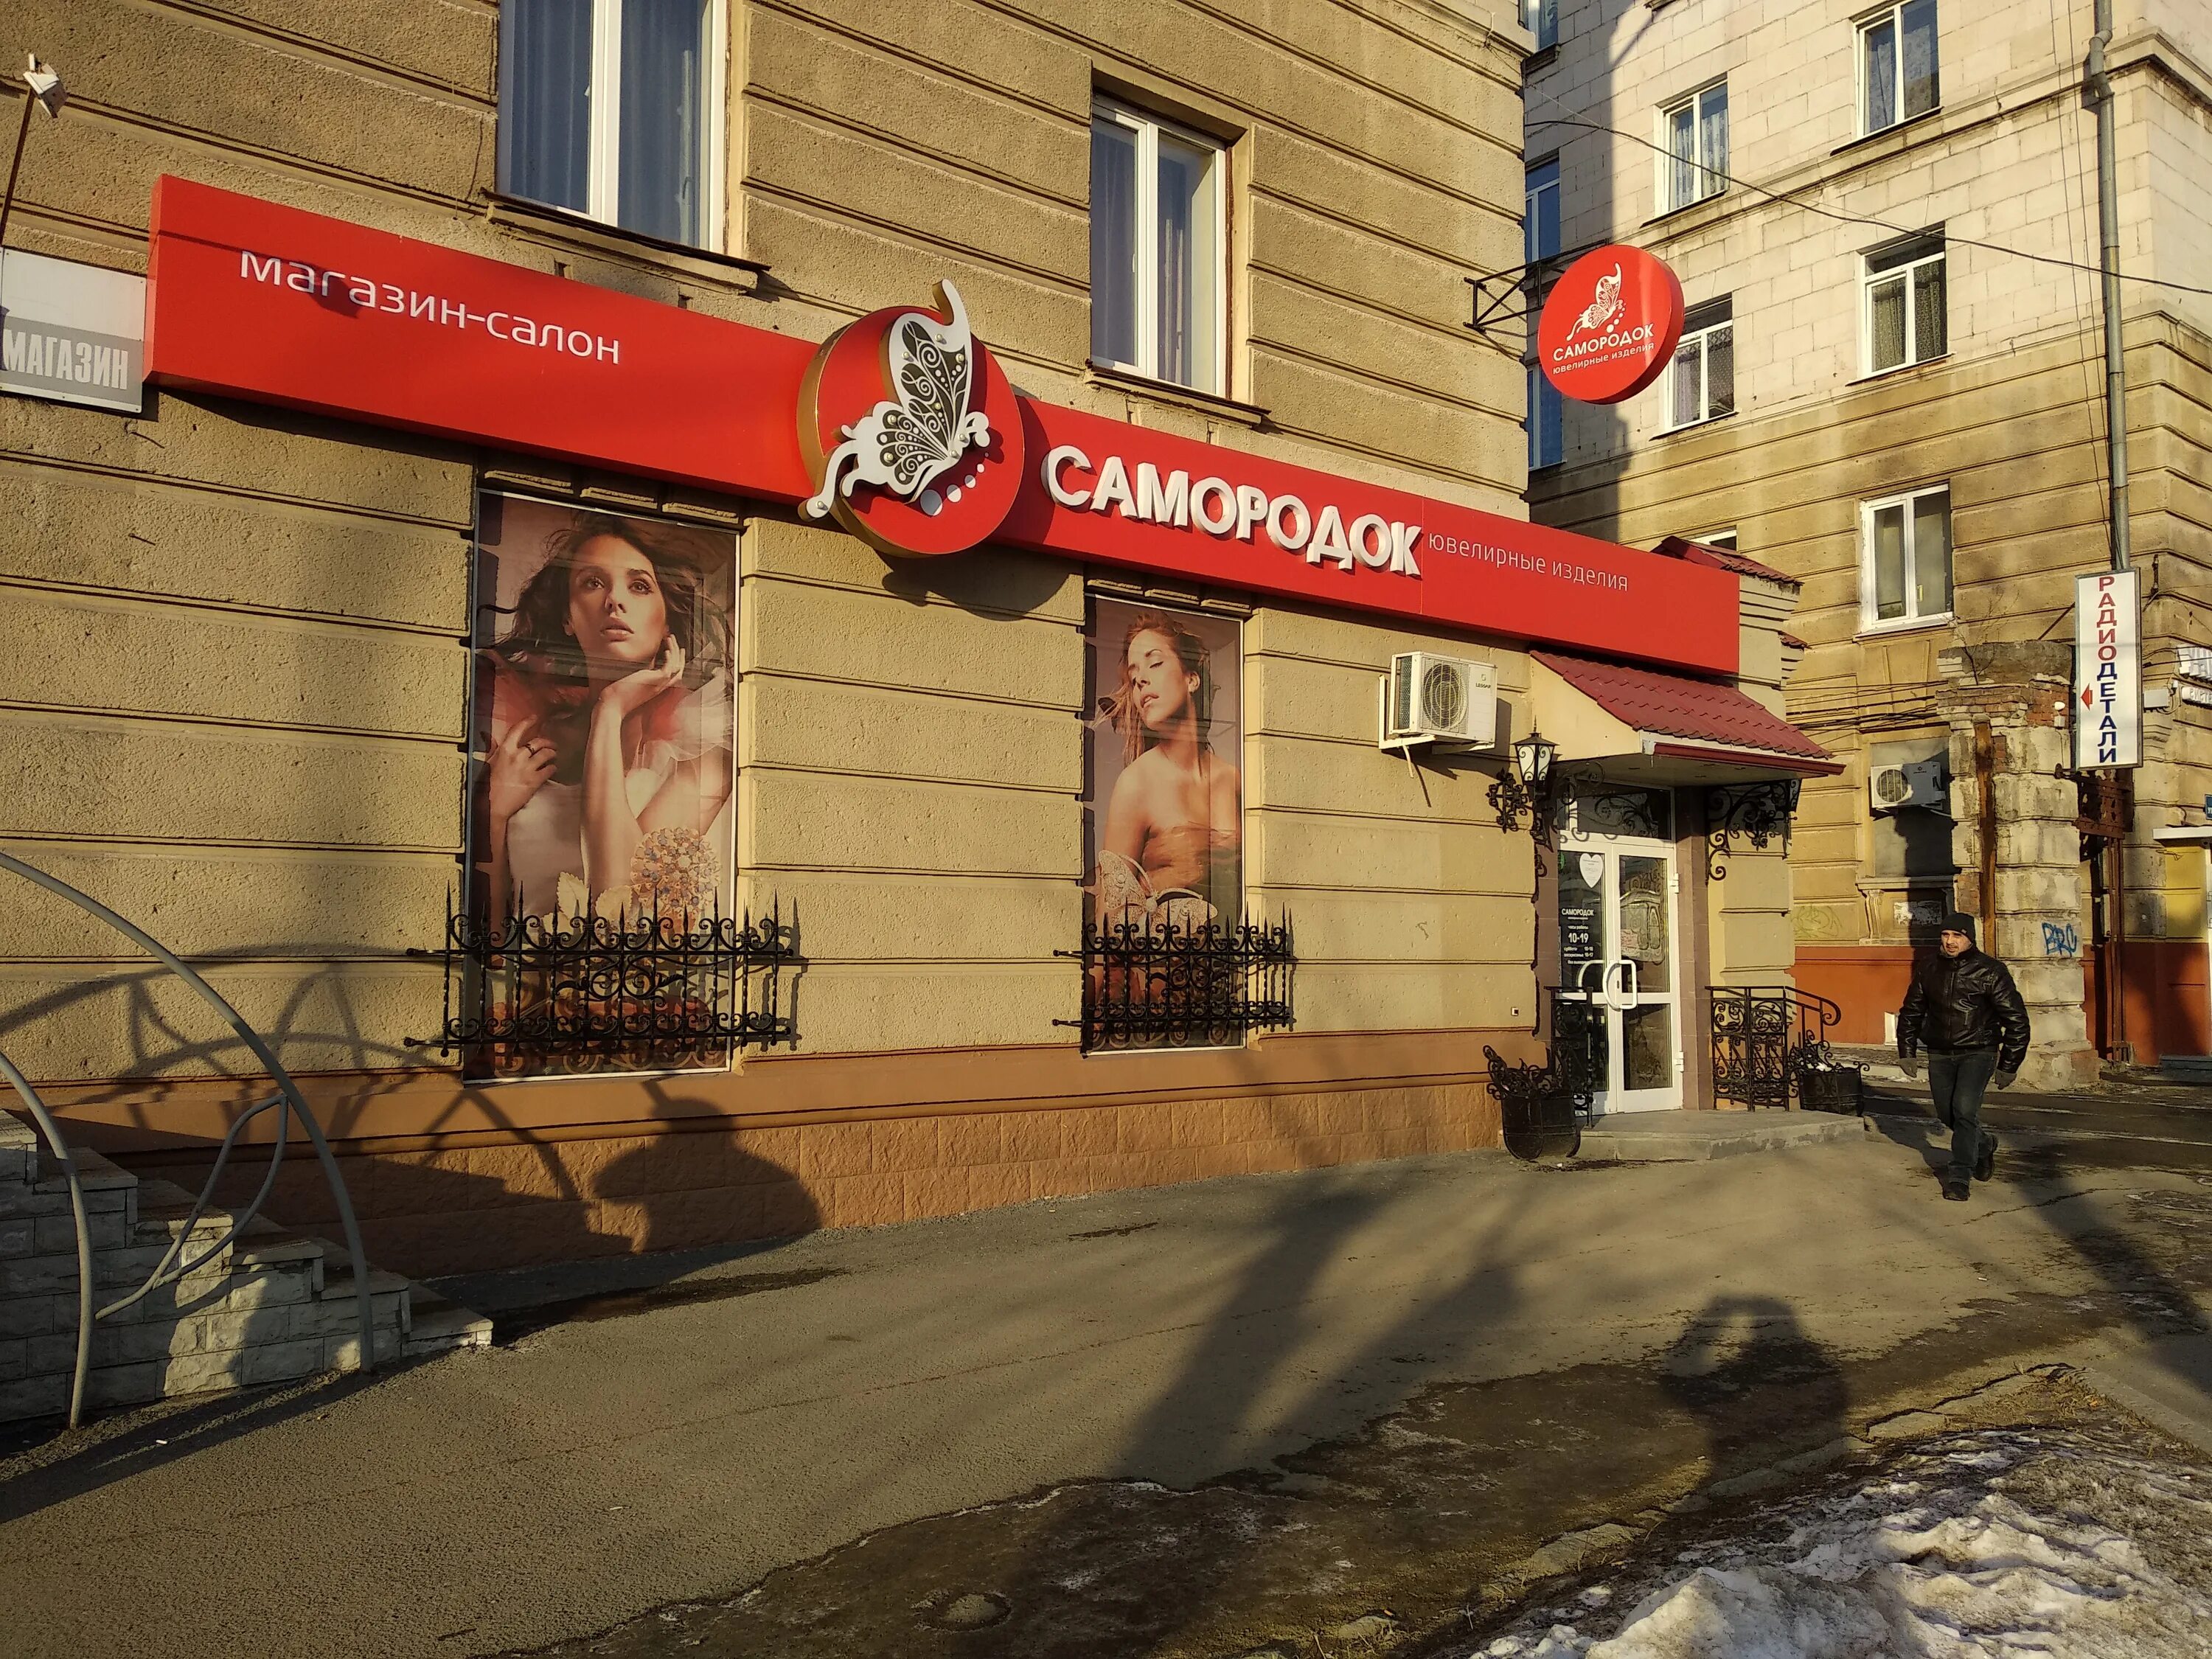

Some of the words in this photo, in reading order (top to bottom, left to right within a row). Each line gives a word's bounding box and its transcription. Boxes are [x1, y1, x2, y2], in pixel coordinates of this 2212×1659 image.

[240, 251, 619, 364] магазин-салон
[3, 329, 128, 390] МАГАЗИН
[1553, 323, 1654, 361] САМОРОДОК
[1553, 355, 1609, 375] ювелирные
[1611, 342, 1654, 360] изделия
[1040, 445, 1422, 578] САМОРОДОК
[1429, 532, 1546, 574] ювелирные
[1552, 560, 1629, 591] изделия
[2096, 576, 2118, 763] РАДИОДЕТАЛИ
[1562, 908, 1594, 917] САМОРОДОК
[1568, 933, 1589, 943] 10-19
